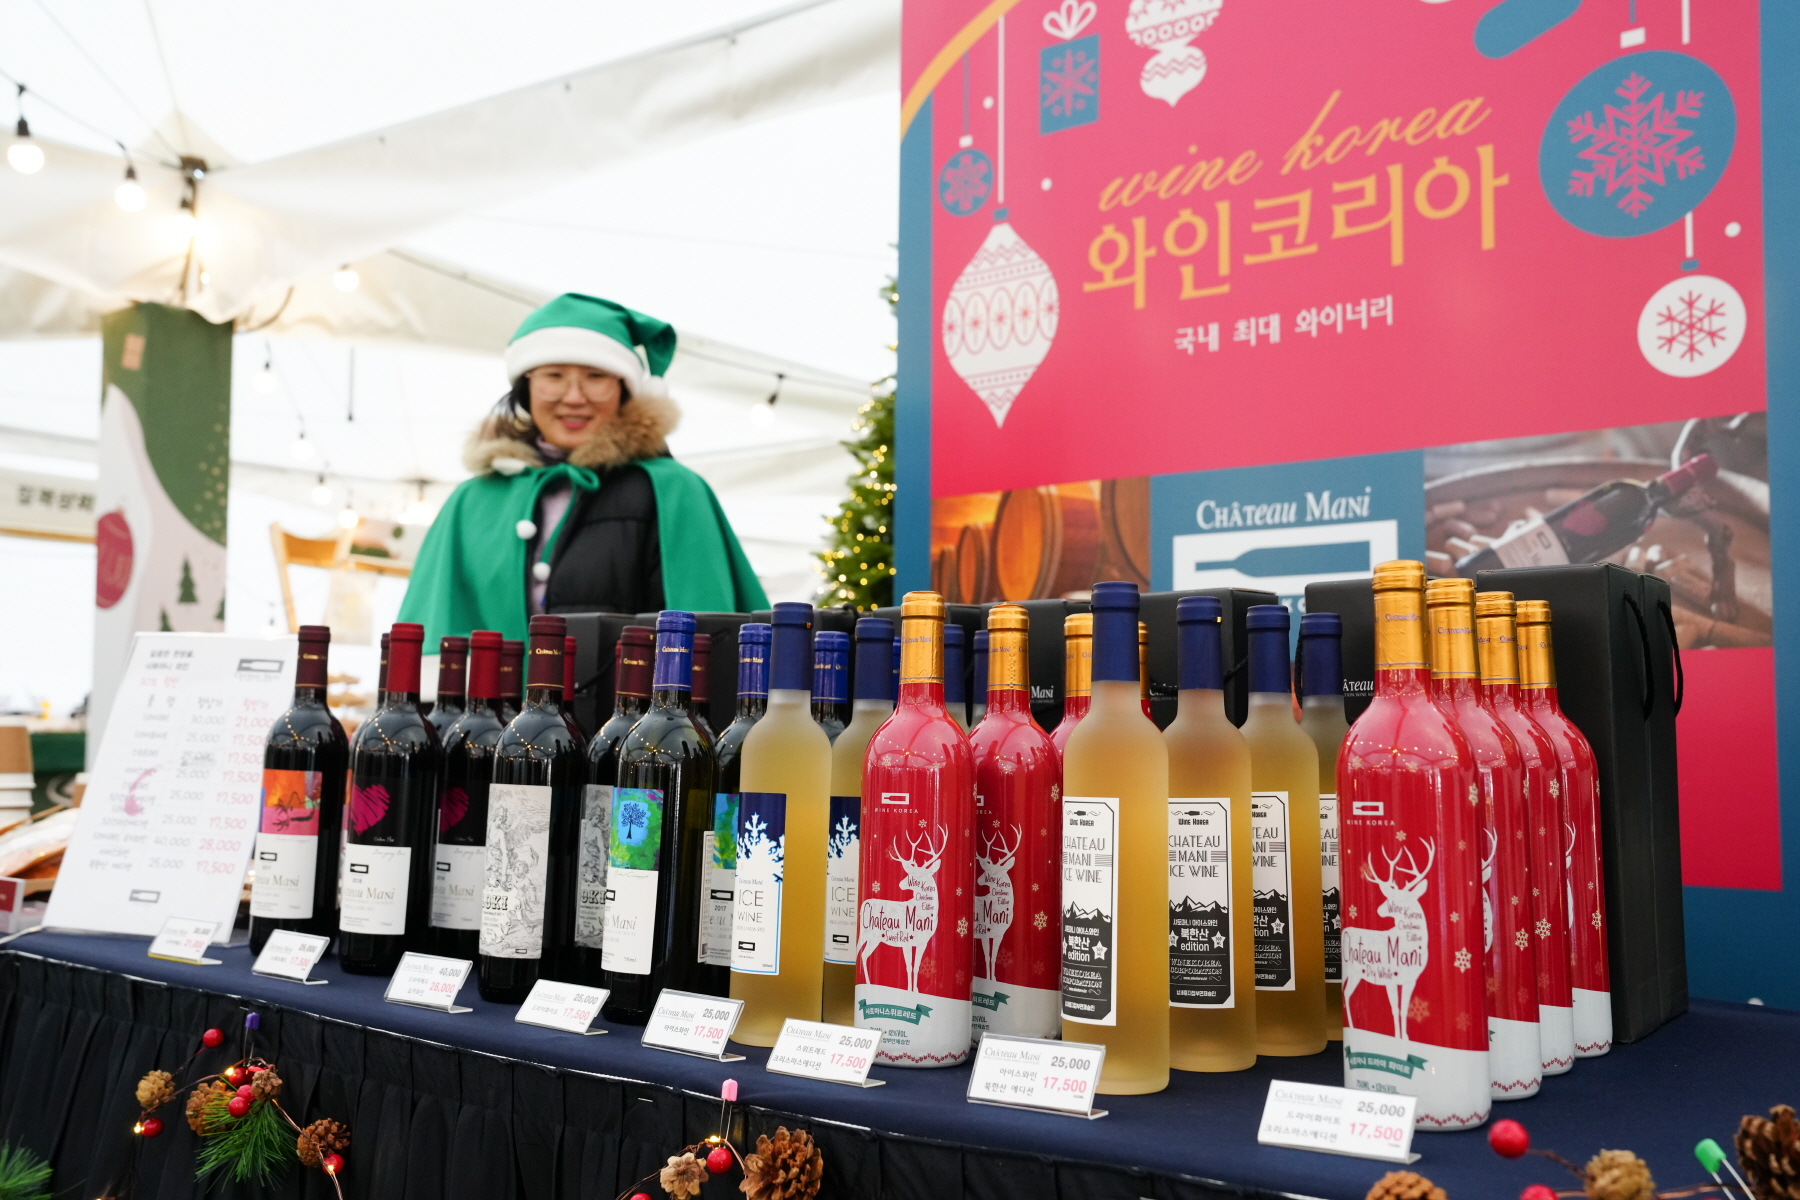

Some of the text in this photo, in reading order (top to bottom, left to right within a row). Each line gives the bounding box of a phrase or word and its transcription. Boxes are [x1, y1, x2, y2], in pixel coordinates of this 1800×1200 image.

[1099, 89, 1492, 212] wine korea
[1083, 143, 1509, 310] 와인코리아
[1174, 294, 1393, 354] 국내 최대 와이너리
[223, 771, 260, 783] 17,500
[217, 791, 254, 805] 17,500
[210, 816, 247, 830] 17,500
[200, 838, 241, 852] 28,000
[1064, 835, 1105, 851] CHATEAU
[1169, 835, 1220, 847] CHATEAU
[1068, 852, 1091, 866] MANI
[1178, 850, 1207, 862] MANI
[197, 860, 235, 874] 17,500
[1169, 865, 1219, 878] ICE WINE
[984, 873, 1011, 888] Wine Korea
[1064, 867, 1102, 883] ICE WINE
[907, 876, 936, 892] Wine Korea
[738, 889, 764, 907] ICE
[831, 886, 855, 903] ICE
[737, 911, 763, 923] WINE
[831, 907, 855, 918] WINE
[862, 902, 934, 932] Chateau Mani
[983, 900, 1009, 924] Mani
[1387, 900, 1423, 920] Wine Korea
[899, 932, 910, 942] Red
[1180, 928, 1209, 941] 북한산
[1068, 935, 1090, 951] 북한산
[1180, 942, 1210, 952] edition
[1343, 931, 1381, 964] Chateau
[1388, 935, 1422, 967] Mani
[290, 956, 311, 967] 17,500
[1067, 951, 1090, 962] edition
[439, 967, 462, 978] 40,000
[1365, 966, 1393, 983] Dry White
[429, 982, 456, 994] 28,000
[573, 993, 599, 1005] 25,000
[562, 1007, 591, 1021] 17,500
[702, 1008, 730, 1021] 25,000
[664, 1024, 724, 1040] 아이스와인 17,500
[838, 1035, 873, 1050] 25,000
[772, 1053, 822, 1071] 크리스마스에디션
[796, 1043, 867, 1069] 스위트레드 17,500
[1051, 1056, 1091, 1071] 25,000
[999, 1068, 1087, 1093] 아이스와인 17,500
[984, 1081, 1034, 1097] 북한산 에디션
[1357, 1100, 1405, 1118] 25,000
[1286, 1110, 1403, 1142] 드라이화이트 17,500
[1264, 1124, 1338, 1144] 크리스마스에디션
